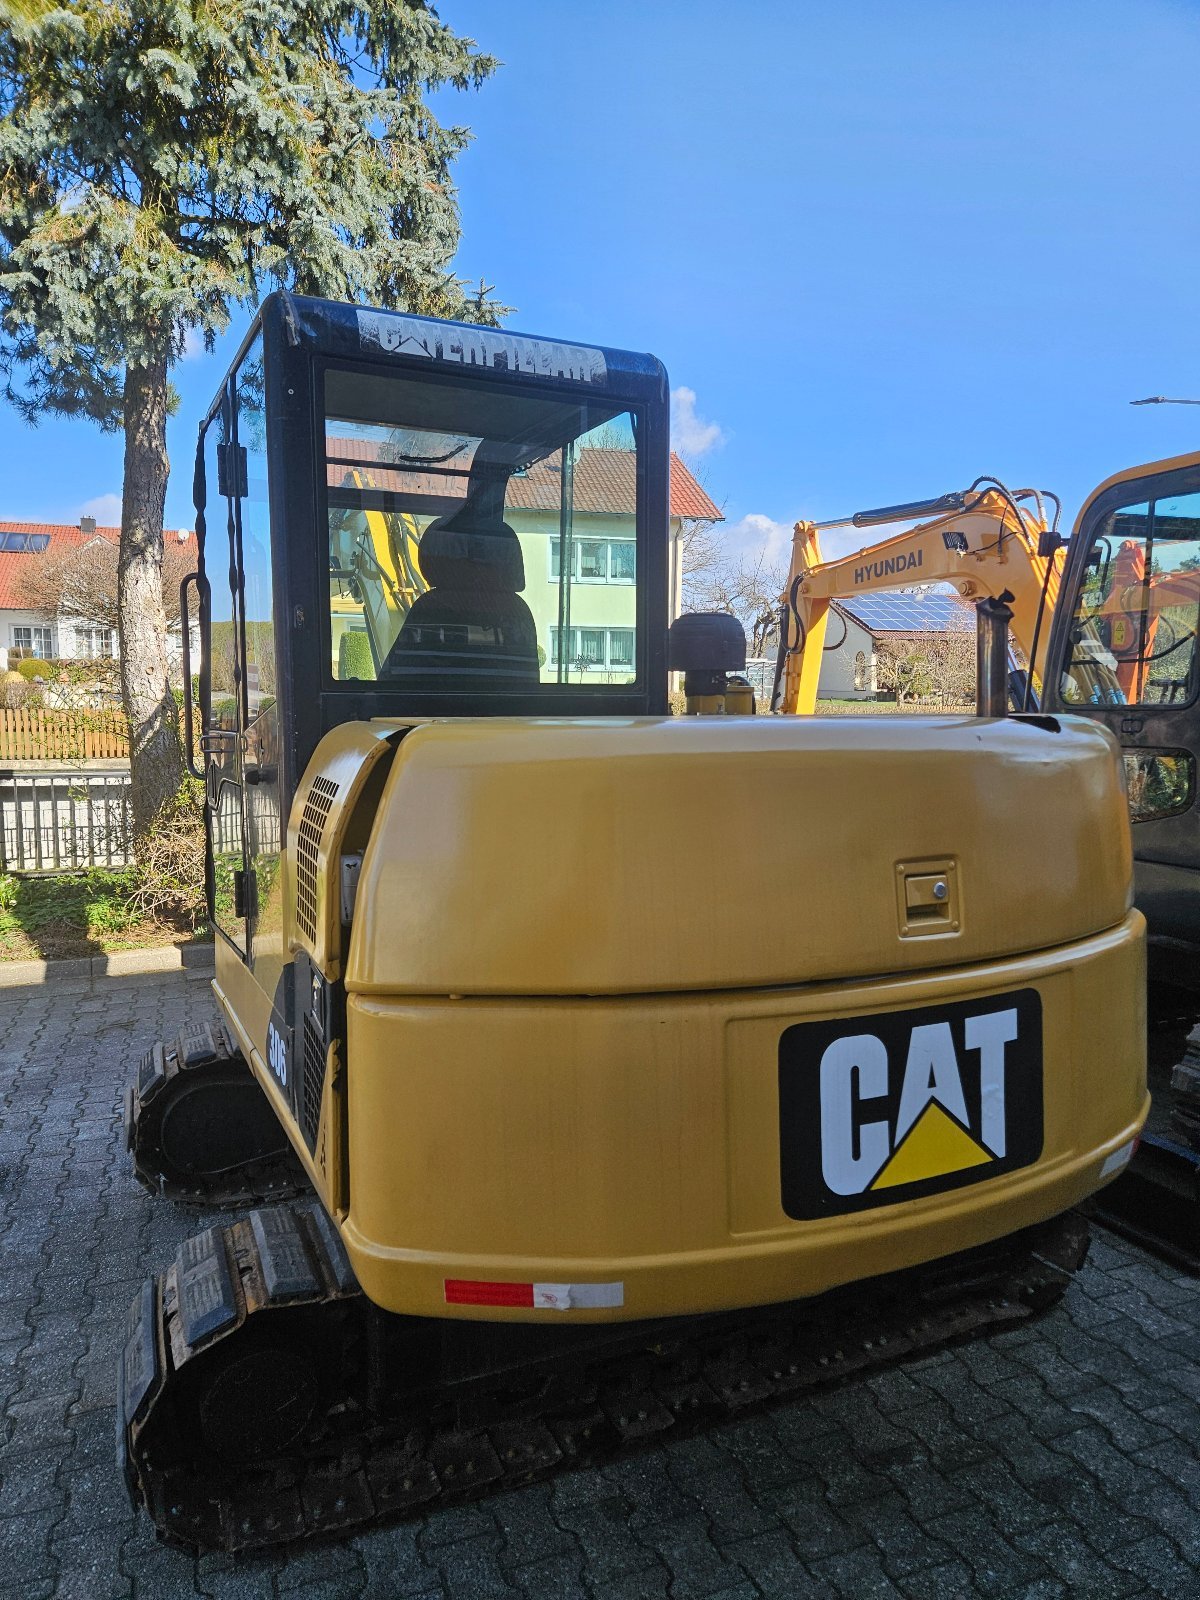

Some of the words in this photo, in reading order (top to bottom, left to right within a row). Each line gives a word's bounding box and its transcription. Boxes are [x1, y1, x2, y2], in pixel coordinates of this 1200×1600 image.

[854, 549, 923, 584] HYUNDAI
[269, 1022, 287, 1086] 306
[819, 1007, 1018, 1196] CAT
